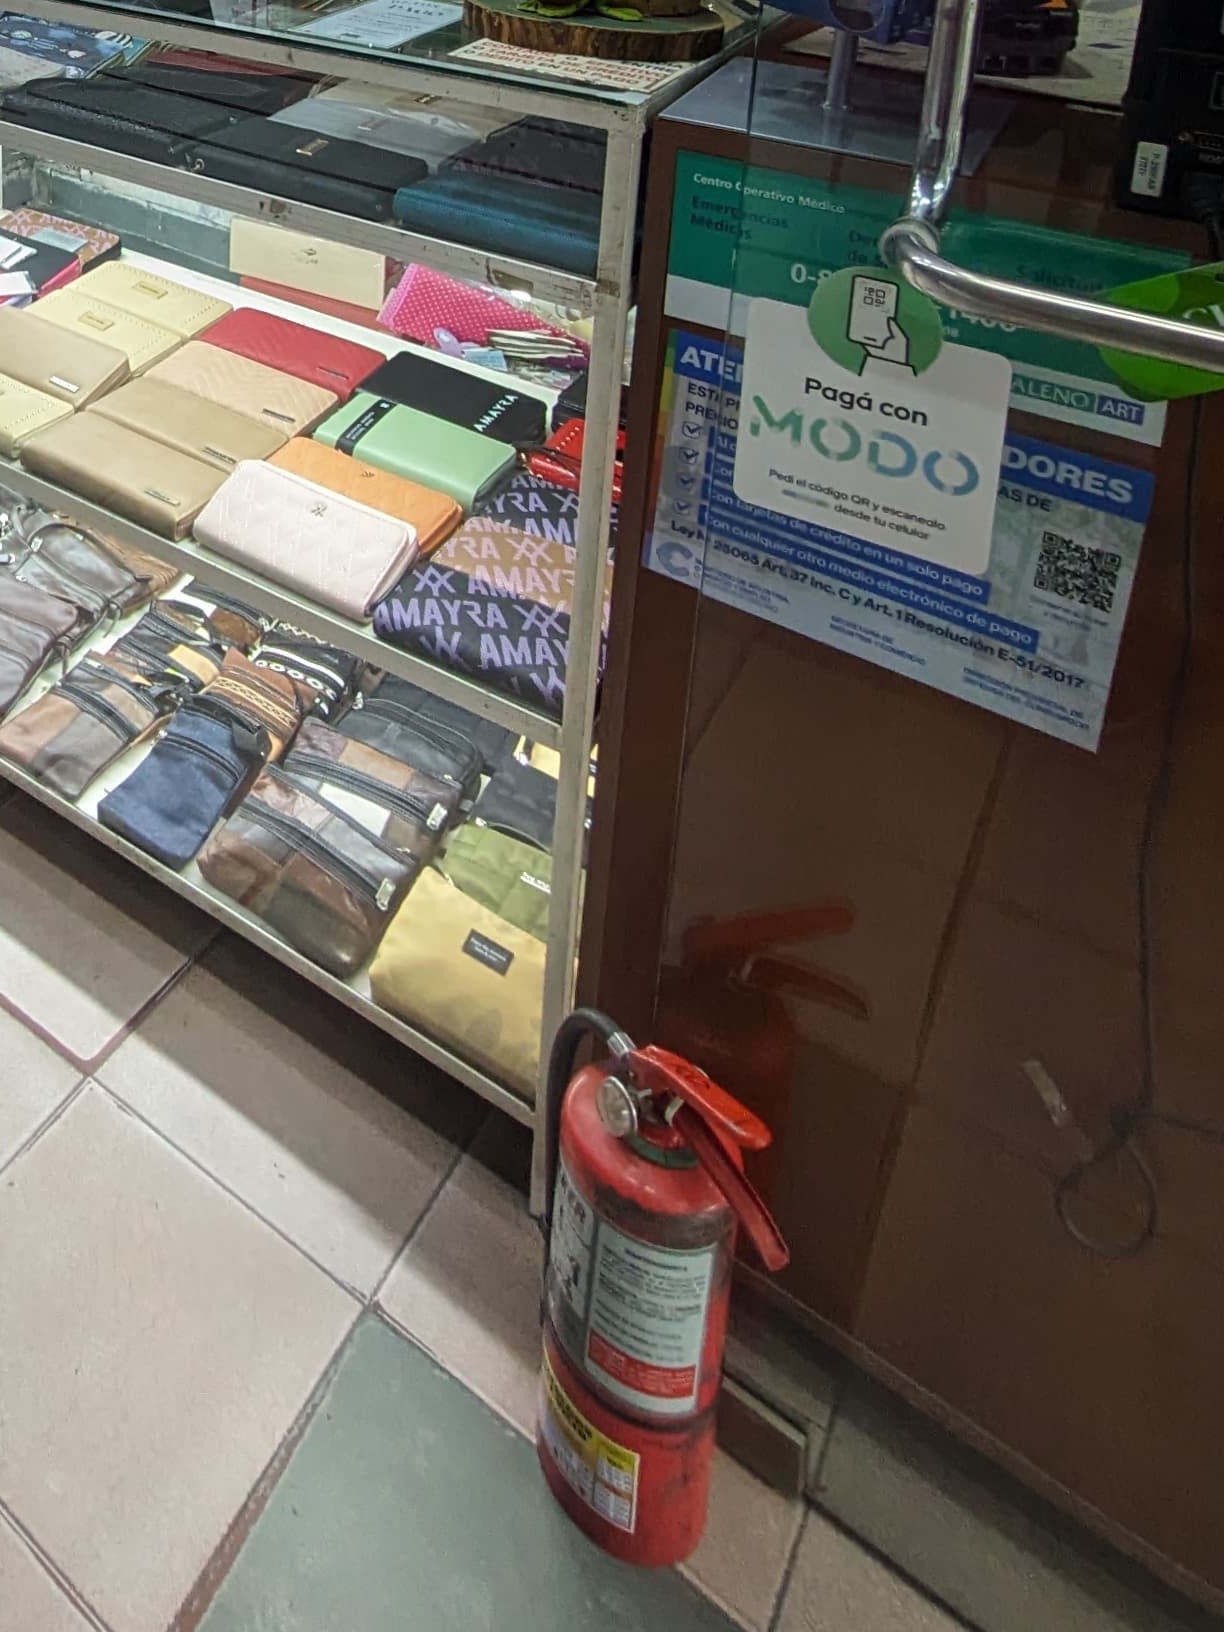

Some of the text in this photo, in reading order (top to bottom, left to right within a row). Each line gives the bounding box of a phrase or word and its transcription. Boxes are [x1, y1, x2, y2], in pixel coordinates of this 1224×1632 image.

[693, 172, 733, 190] Centro
[473, 393, 519, 433] AMAYRA
[804, 376, 929, 427] Pagá con
[1012, 374, 1142, 422] ALENO ART
[749, 394, 980, 497] MODO
[1002, 445, 1135, 504] DORES
[834, 503, 930, 541] desde tu celular
[851, 494, 871, 509] QR
[1026, 492, 1054, 513] DE
[789, 519, 808, 534] de
[863, 544, 883, 561] en
[884, 551, 905, 570] un
[941, 570, 984, 597] pago
[671, 519, 695, 540] Ley
[789, 568, 808, 584] 37
[839, 587, 853, 601] C
[904, 611, 996, 657] Resolución
[796, 548, 827, 569] otro
[827, 560, 875, 586] medio
[966, 610, 988, 628] de
[989, 619, 1034, 647] pago
[376, 598, 508, 635] AMAYRA
